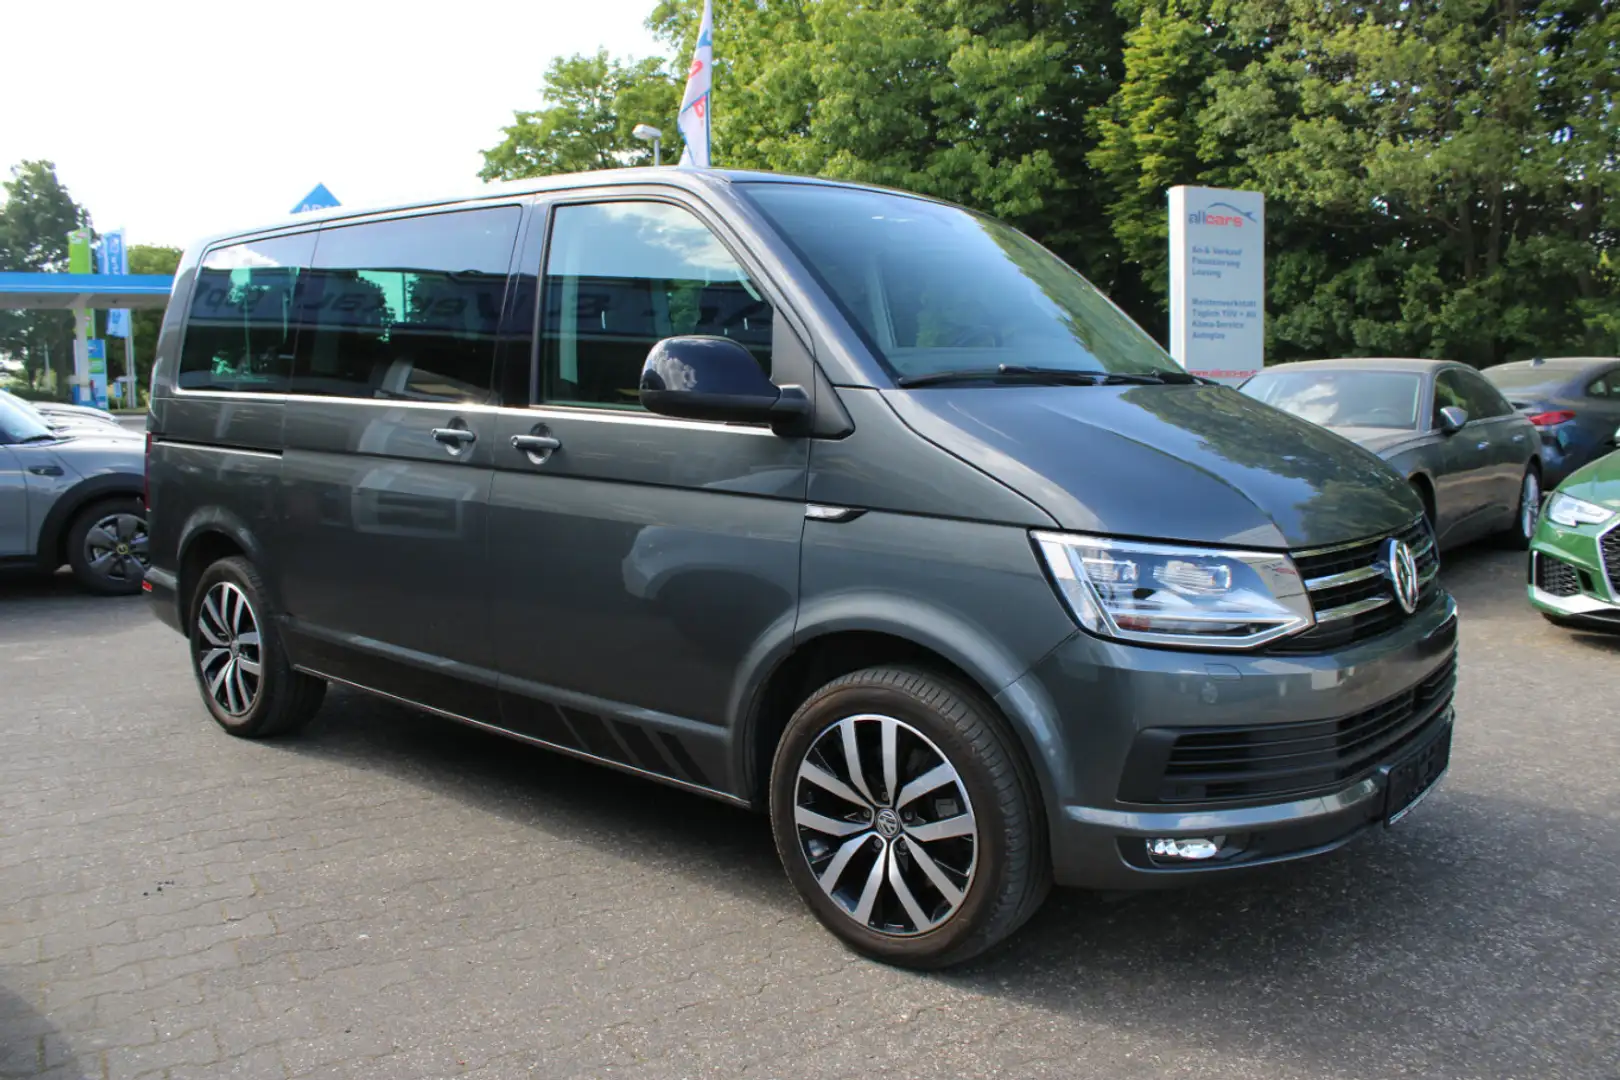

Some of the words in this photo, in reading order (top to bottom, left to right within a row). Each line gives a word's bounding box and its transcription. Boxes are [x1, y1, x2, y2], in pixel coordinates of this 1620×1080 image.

[1188, 210, 1244, 228] allcars
[1191, 256, 1241, 269] Finanzierung
[1191, 268, 1222, 279] Leasing
